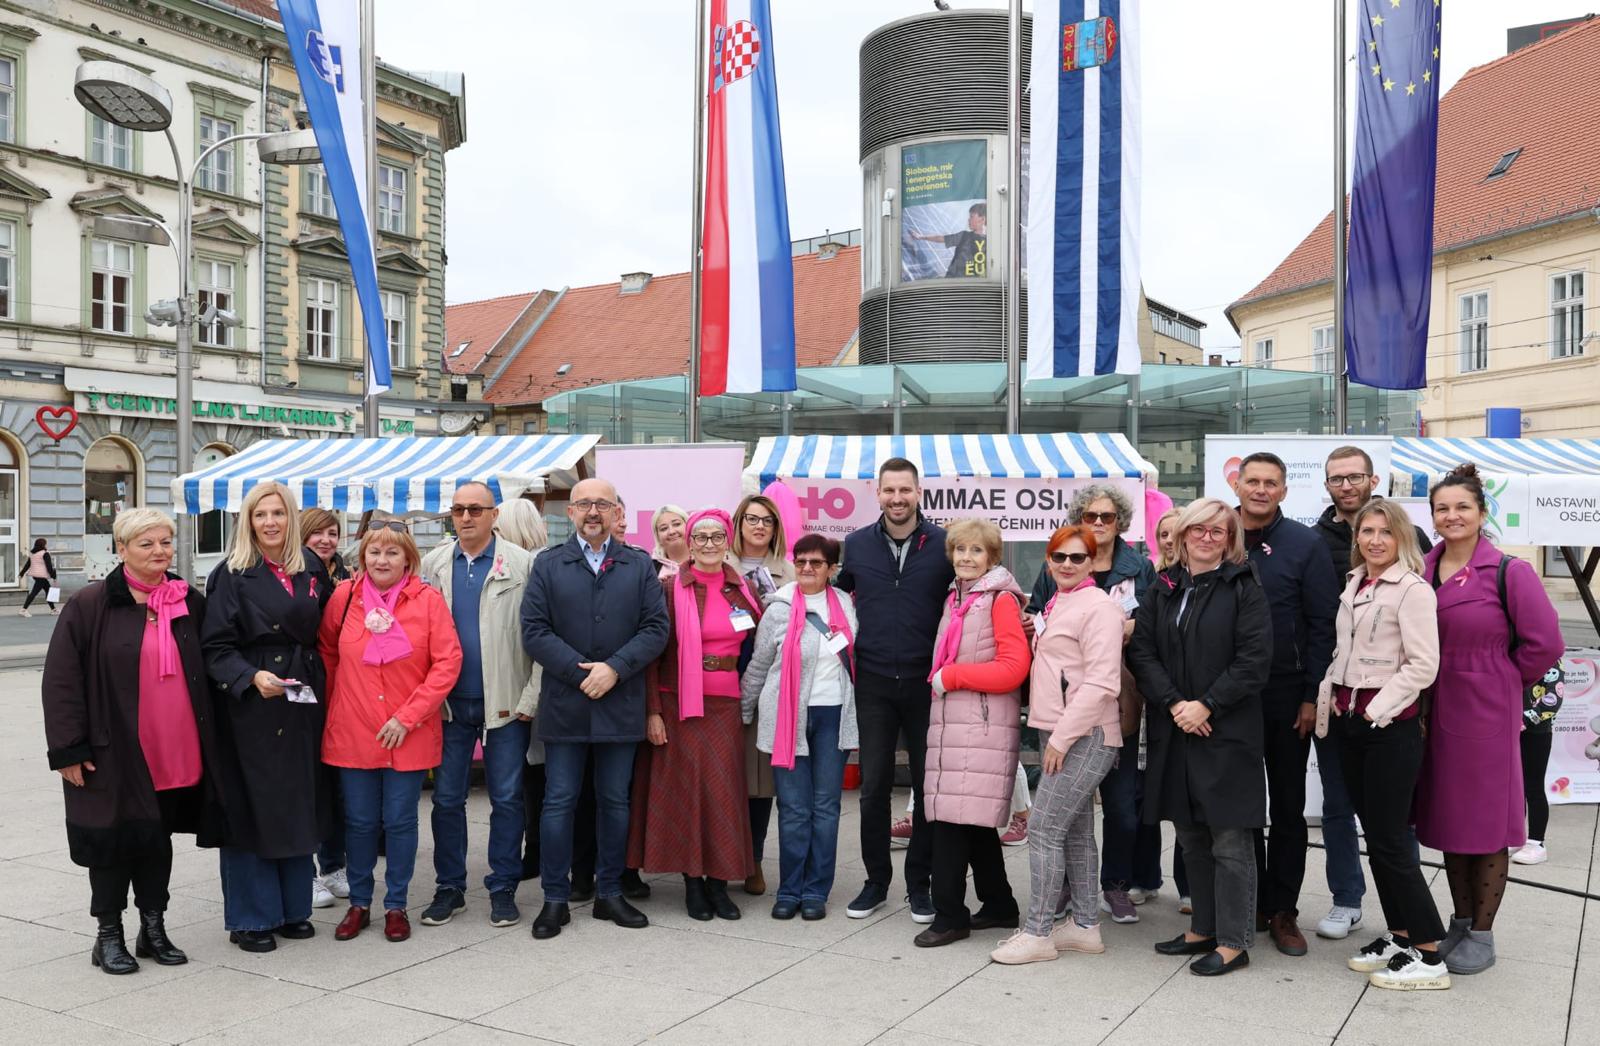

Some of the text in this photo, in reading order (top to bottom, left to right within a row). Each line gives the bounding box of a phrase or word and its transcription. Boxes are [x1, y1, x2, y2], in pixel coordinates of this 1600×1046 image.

[106, 393, 337, 426] CENTRLNA LJEKARNA
[1285, 472, 1311, 480] gram
[917, 488, 1006, 510] MMAE
[1536, 497, 1596, 508] NASTAVNI
